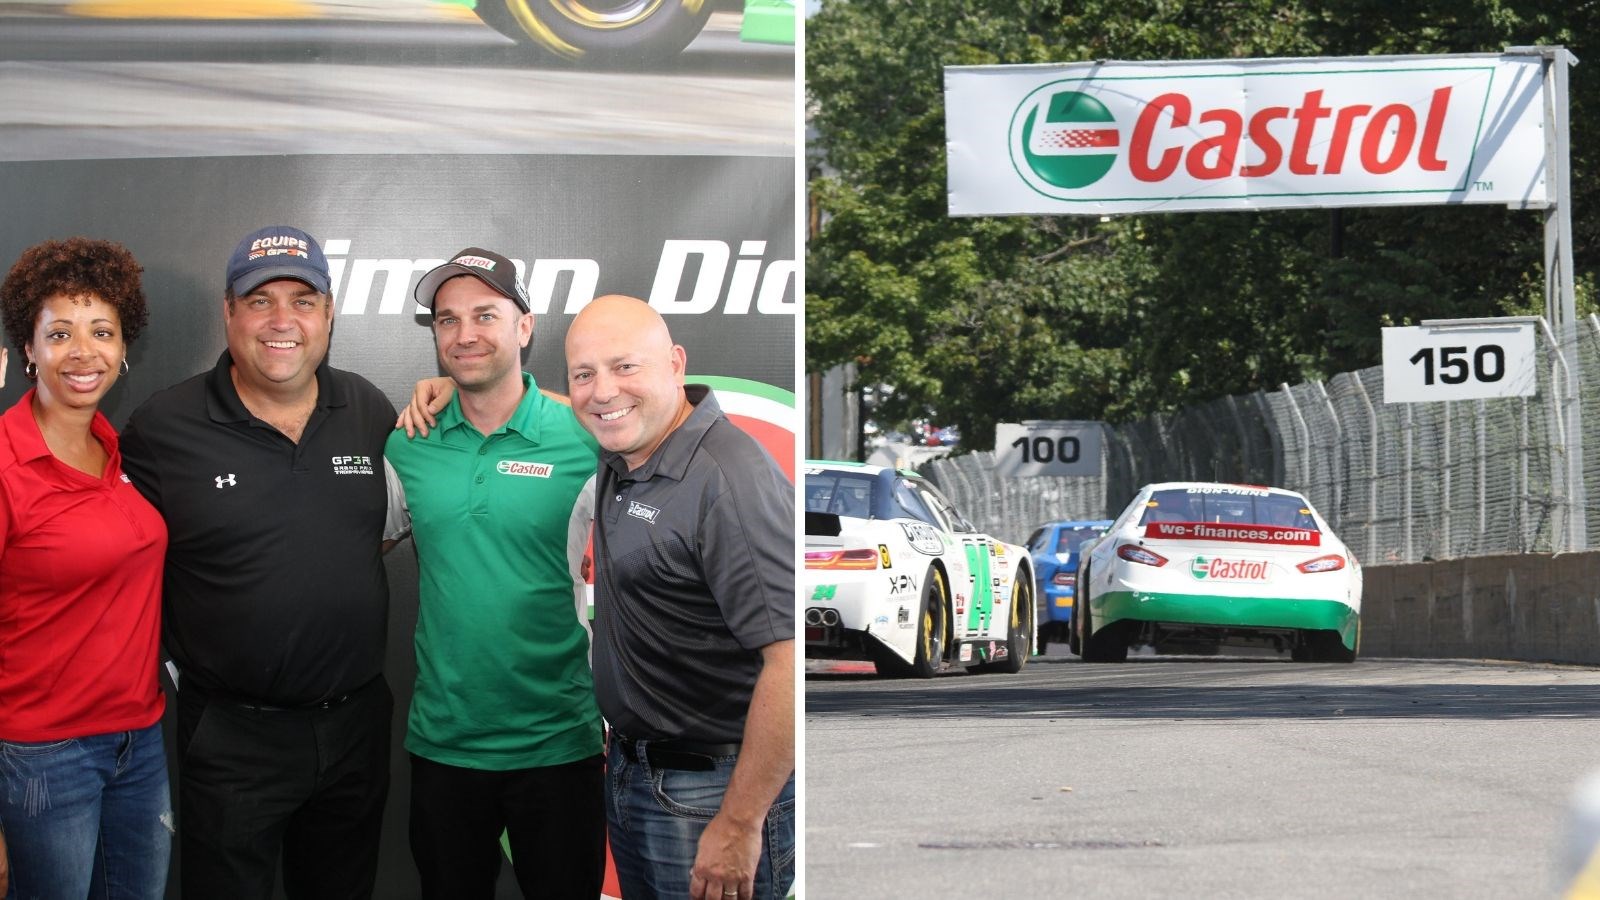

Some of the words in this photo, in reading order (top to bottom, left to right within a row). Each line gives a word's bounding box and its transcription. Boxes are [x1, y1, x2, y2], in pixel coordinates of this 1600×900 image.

[1129, 86, 1453, 183] Castrol
[1473, 181, 1493, 191] TM
[325, 240, 600, 315] imn
[1409, 344, 1505, 386] 150
[1012, 436, 1080, 463] 100
[331, 456, 371, 465] GP3R
[510, 463, 549, 476] Castrol
[632, 504, 656, 520] Castrol
[1159, 523, 1311, 541] we-finances.com
[1209, 558, 1268, 580] Castrol
[811, 584, 838, 600] 24
[889, 574, 917, 595] XPN
